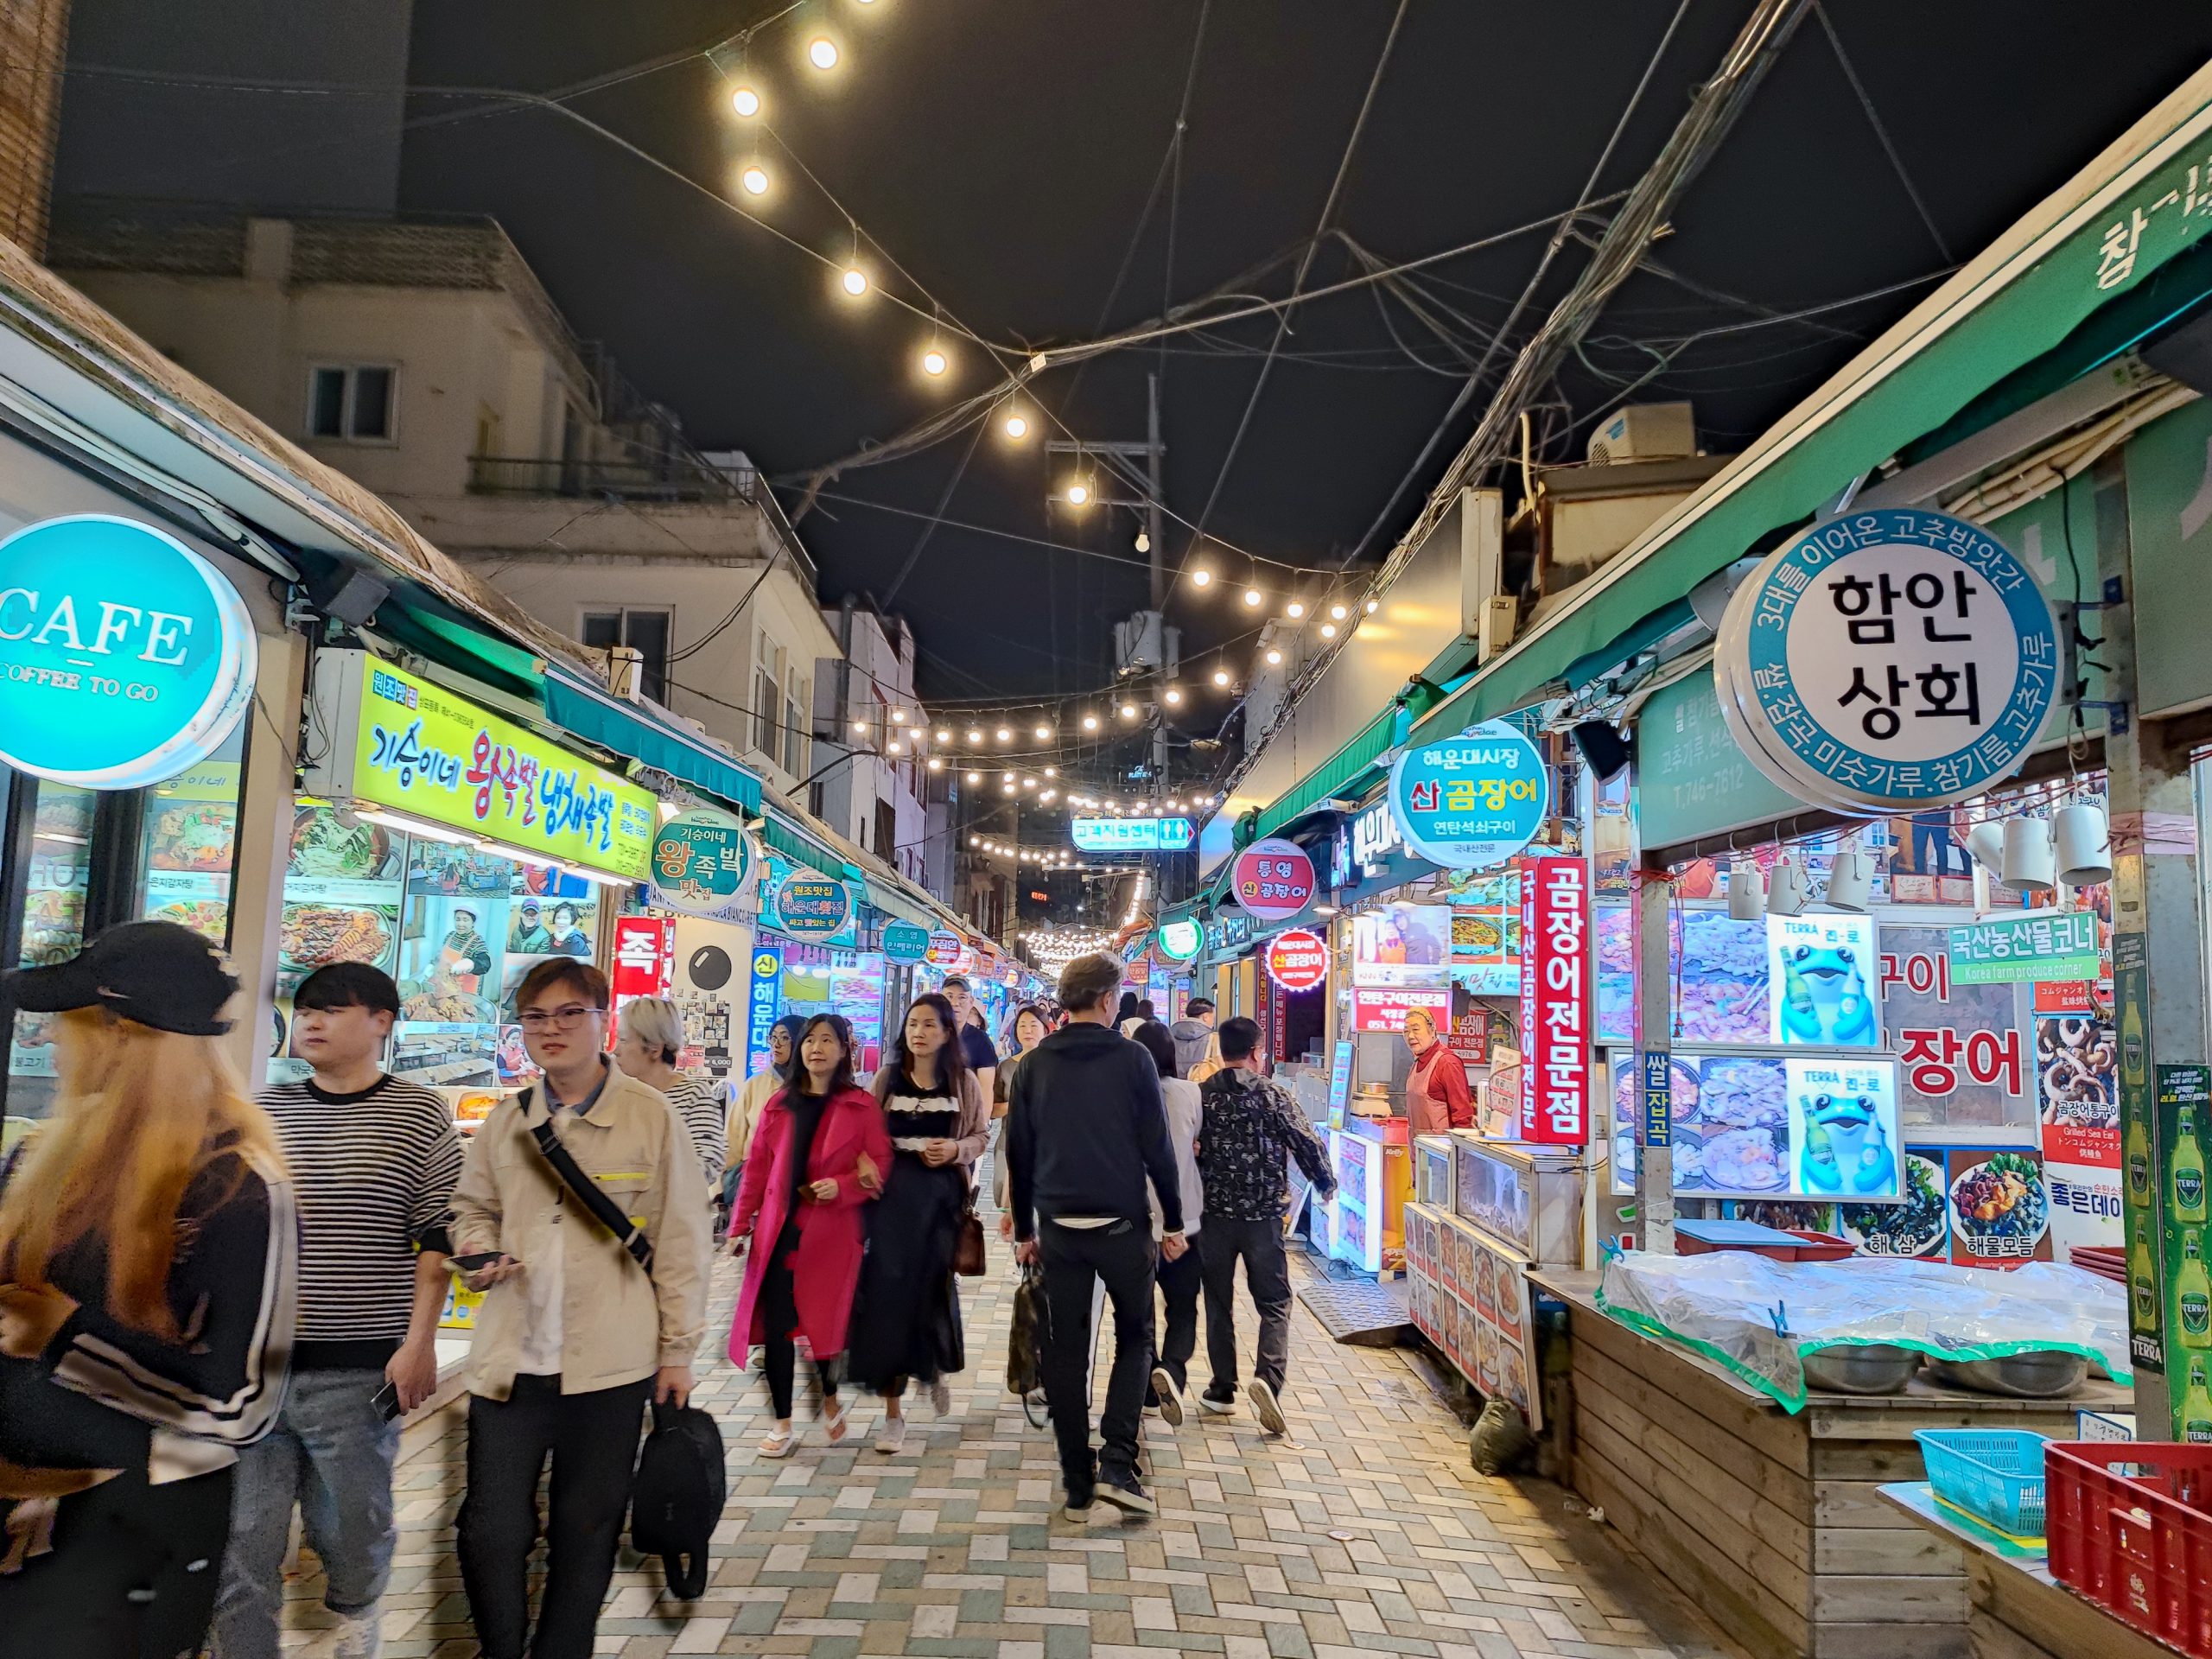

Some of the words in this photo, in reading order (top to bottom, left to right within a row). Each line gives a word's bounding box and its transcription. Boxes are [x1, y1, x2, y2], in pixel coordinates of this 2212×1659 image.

[1758, 563, 1812, 632] 3대를
[1803, 515, 1885, 565] 이어온
[1890, 516, 2023, 595] 고추방앗간
[1827, 570, 1978, 645] 함안
[0, 588, 194, 666] CAFE
[89, 676, 121, 696] TO
[125, 683, 159, 702] GO
[1837, 662, 1980, 741] 상회
[1421, 747, 1521, 770] 해운대시장
[371, 718, 461, 790] 기승이네
[466, 729, 541, 828] 왕족발
[540, 766, 618, 853] 냉채족발
[1411, 779, 1443, 812] 산
[1447, 777, 1537, 811] 곰장어
[680, 827, 727, 843] 기승이네
[1076, 824, 1156, 837] 고객지원센터
[1433, 820, 1516, 836] 연탄석쇠구이
[1452, 843, 1496, 854] 국내산전문
[655, 838, 747, 882] 왕족발
[680, 879, 712, 901] 맛집
[794, 886, 833, 897] 원조맛집
[1243, 882, 1255, 896] 산
[781, 899, 845, 916] 해운대횟집
[1783, 922, 1819, 935] TERRA
[1951, 916, 2094, 960] 국산농산물코너
[758, 957, 773, 975] 신
[1965, 965, 1992, 981] Korea
[1992, 964, 2017, 980] farm
[2016, 963, 2054, 980] produce
[2054, 963, 2082, 976] corner
[1357, 991, 1446, 1007] 연탄구이전문점
[1464, 1037, 1484, 1048] 전문점
[1646, 1055, 1669, 1087] 쌀
[1884, 1027, 2023, 1096] 장어
[1803, 1070, 1840, 1084] TERRA
[1647, 1092, 1669, 1146] 잡곡
[2059, 1101, 2120, 1121] 곰장어통구이
[2063, 1127, 2086, 1137] Grilled
[2088, 1128, 2101, 1138] Sea
[1385, 1147, 1405, 1159] Kelly
[2176, 1179, 2202, 1189] TERRA
[1871, 1234, 1916, 1255] 해삼
[1967, 1236, 2034, 1256] 해물모듬
[2182, 1303, 2208, 1313] TERRA
[2132, 1338, 2163, 1363] TERRA
[2188, 1431, 2212, 1442] TERRA
